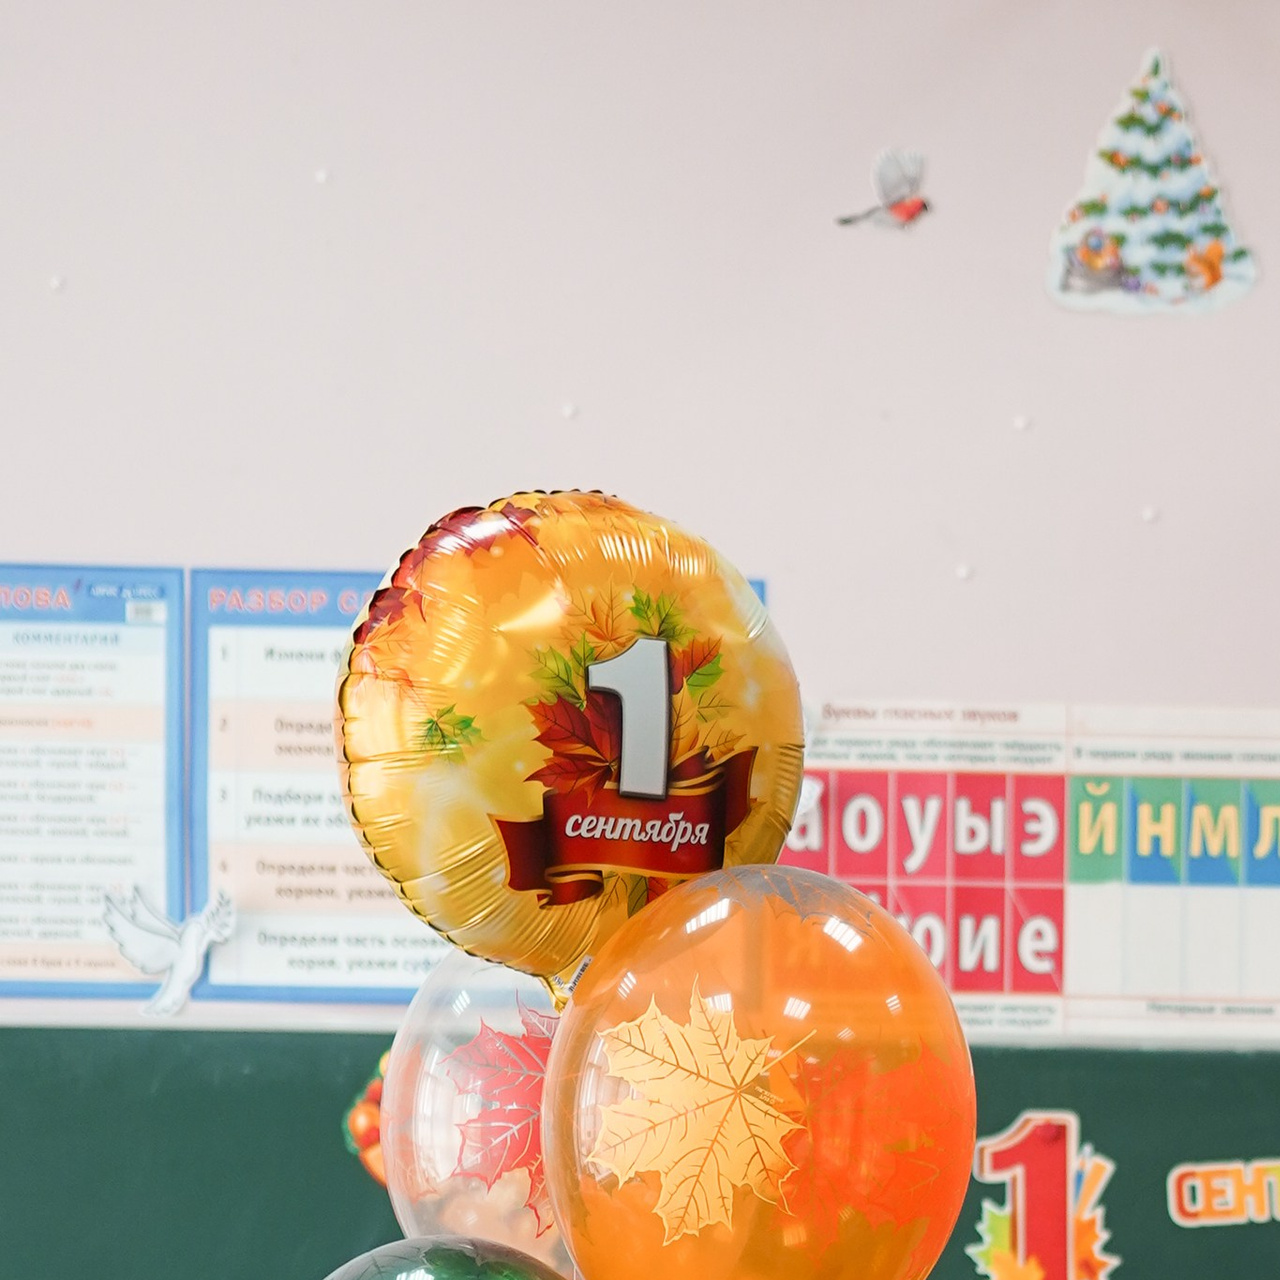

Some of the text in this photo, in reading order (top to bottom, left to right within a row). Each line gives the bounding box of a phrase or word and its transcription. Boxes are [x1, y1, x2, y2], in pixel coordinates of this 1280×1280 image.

[208, 587, 328, 613] РАЗБОР
[587, 637, 671, 799] 1
[564, 812, 710, 852] сентября
[842, 794, 884, 853] о
[901, 796, 942, 875] у
[954, 797, 1006, 854] ы
[1020, 798, 1060, 857] э
[1078, 782, 1117, 856] й
[1137, 803, 1176, 857] н
[1190, 803, 1240, 858] м
[958, 914, 999, 973] и
[1018, 914, 1059, 974] е
